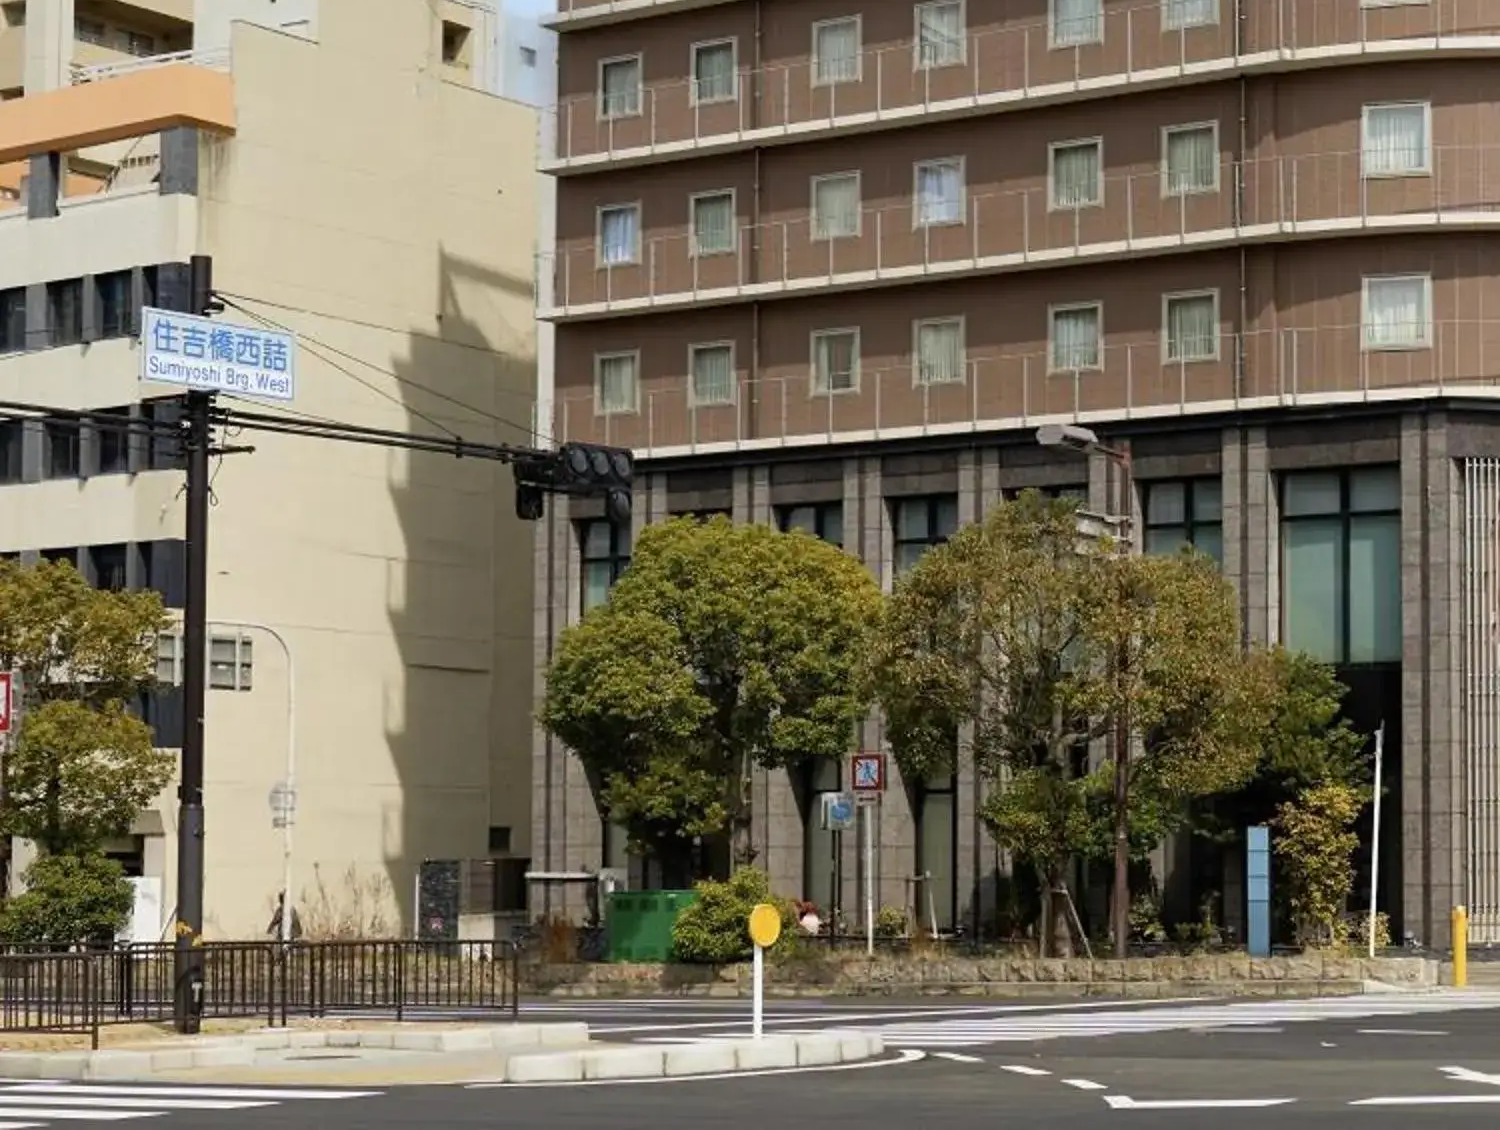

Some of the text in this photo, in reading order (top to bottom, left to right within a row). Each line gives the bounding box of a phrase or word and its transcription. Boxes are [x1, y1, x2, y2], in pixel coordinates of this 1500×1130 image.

[153, 318, 287, 372] 住吉橋西詰
[149, 355, 289, 392] Sumiyoshi Brg. West
